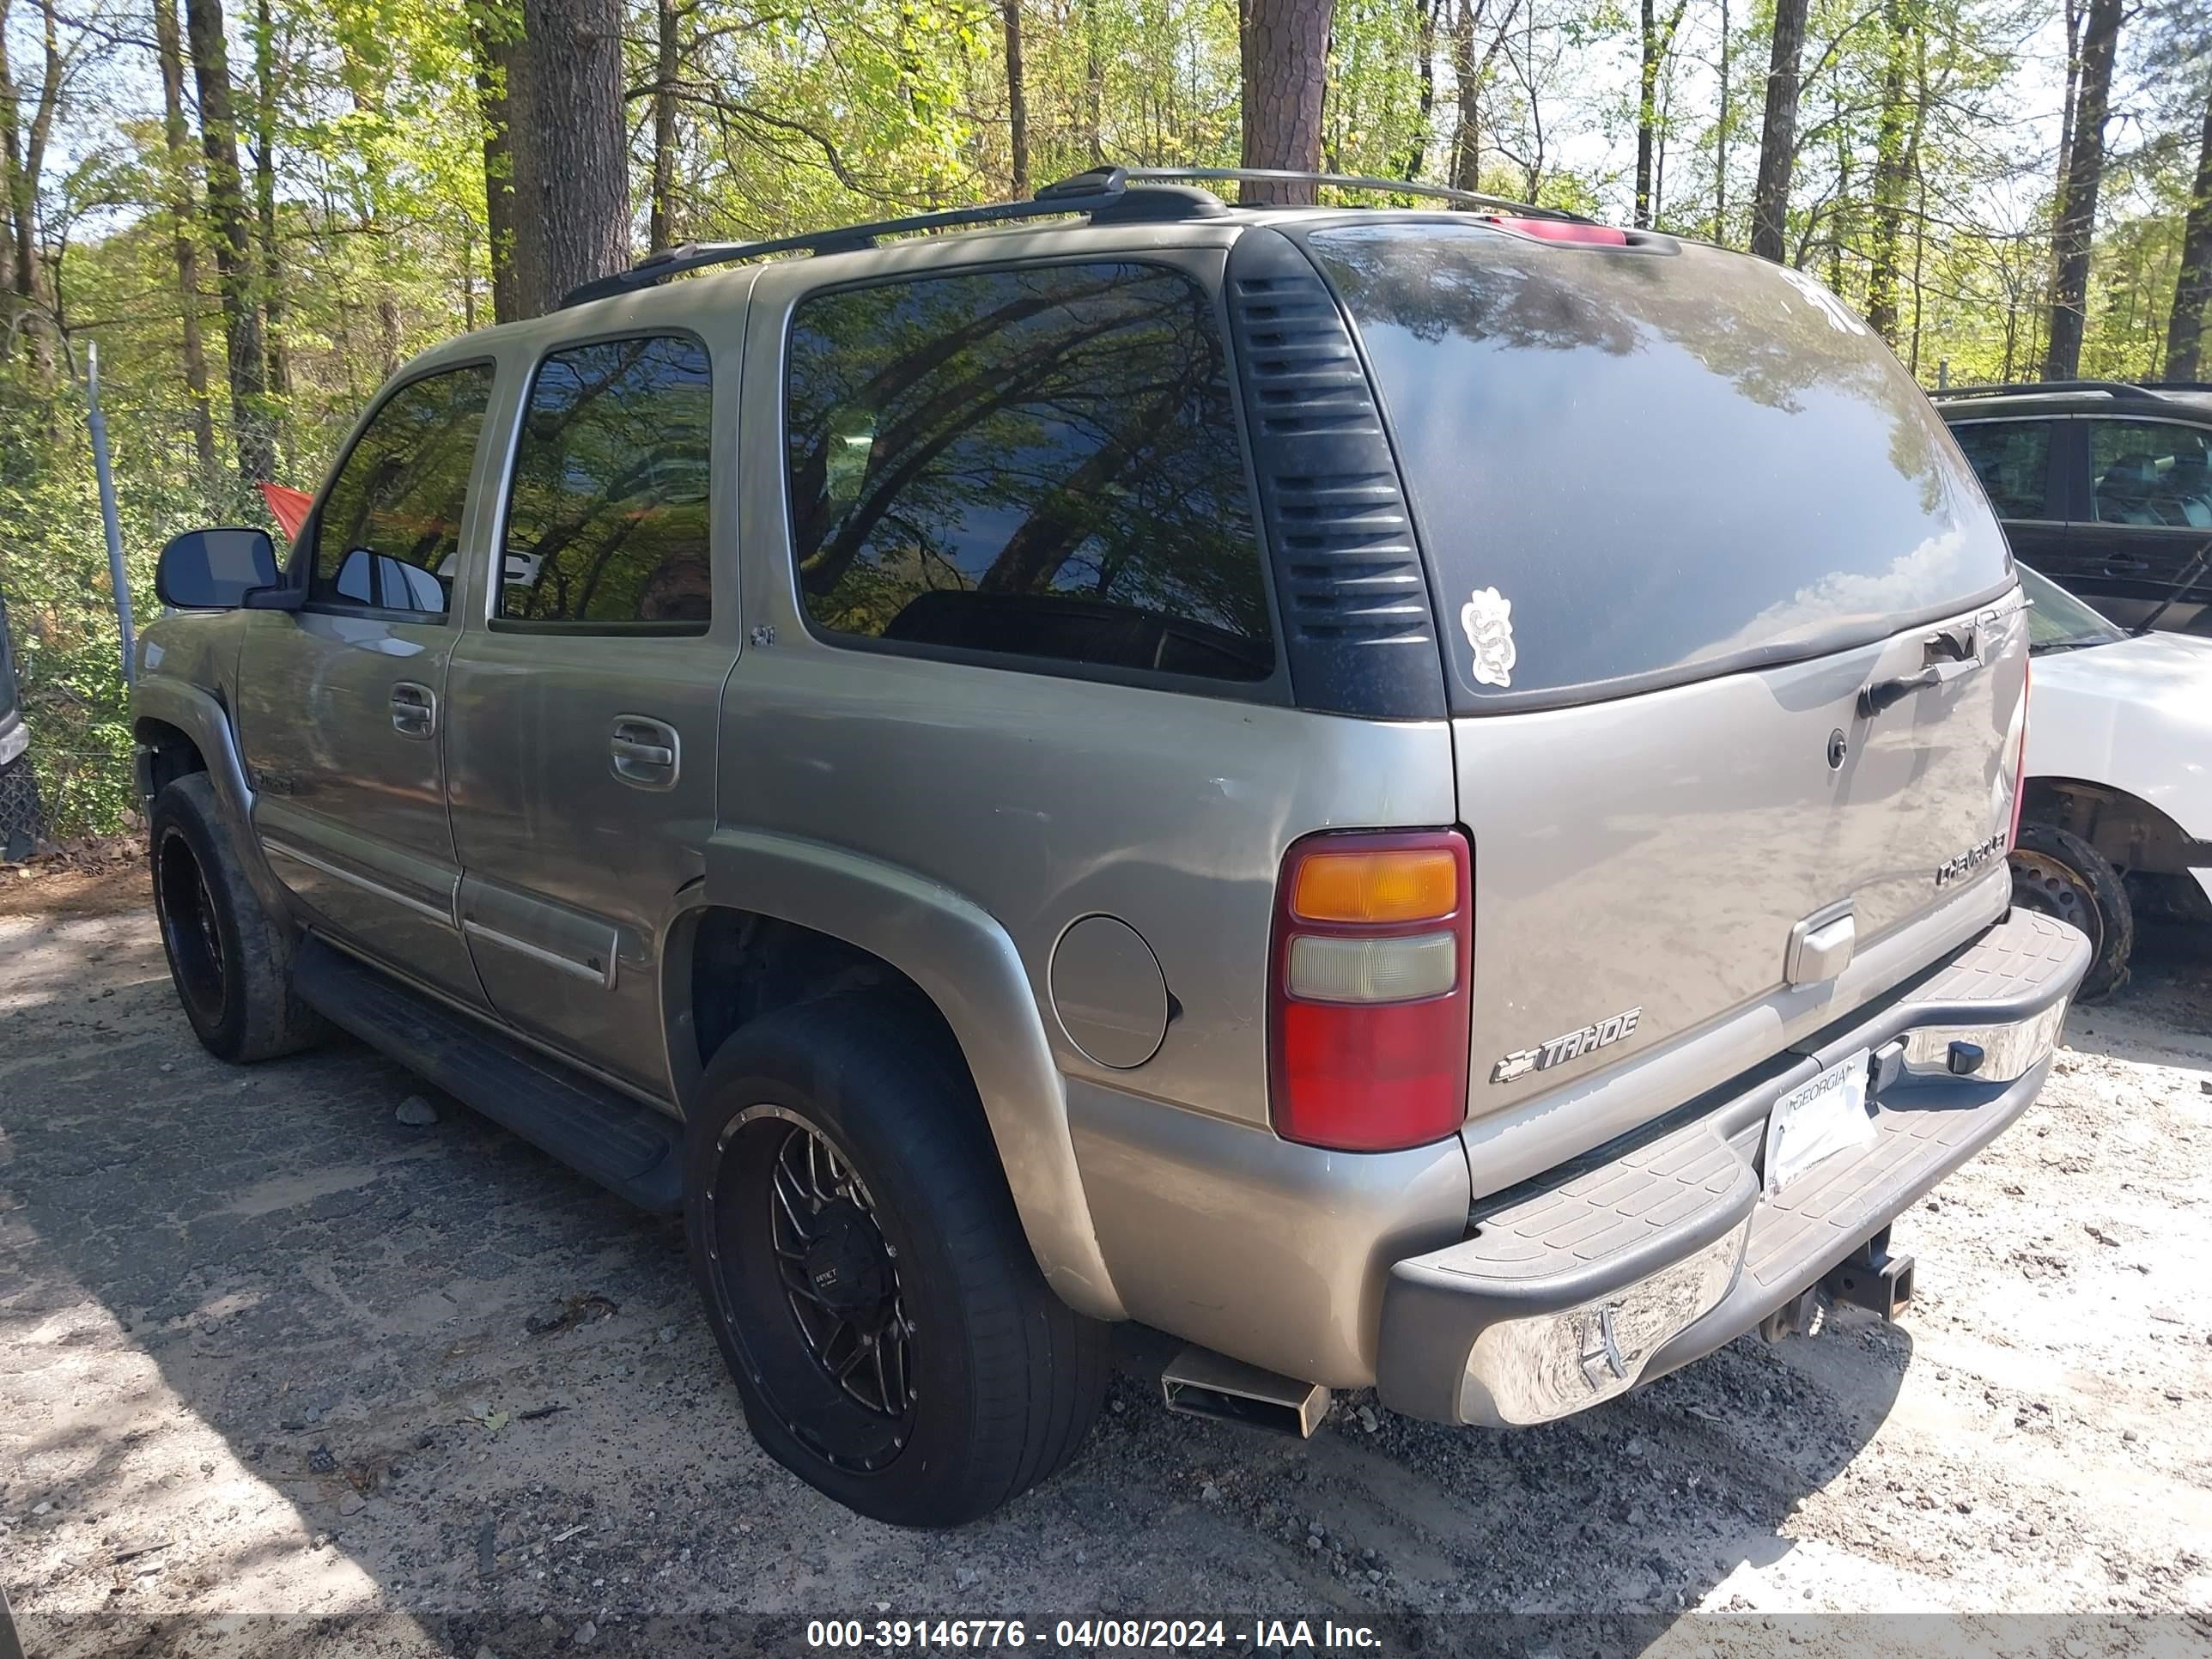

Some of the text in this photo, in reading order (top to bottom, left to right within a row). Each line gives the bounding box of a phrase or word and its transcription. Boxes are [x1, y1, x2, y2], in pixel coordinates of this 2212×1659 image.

[1936, 830, 2008, 885] CHEVROLE
[1538, 1006, 1642, 1071] TAHOE
[1793, 1067, 1846, 1111] GEORGIA
